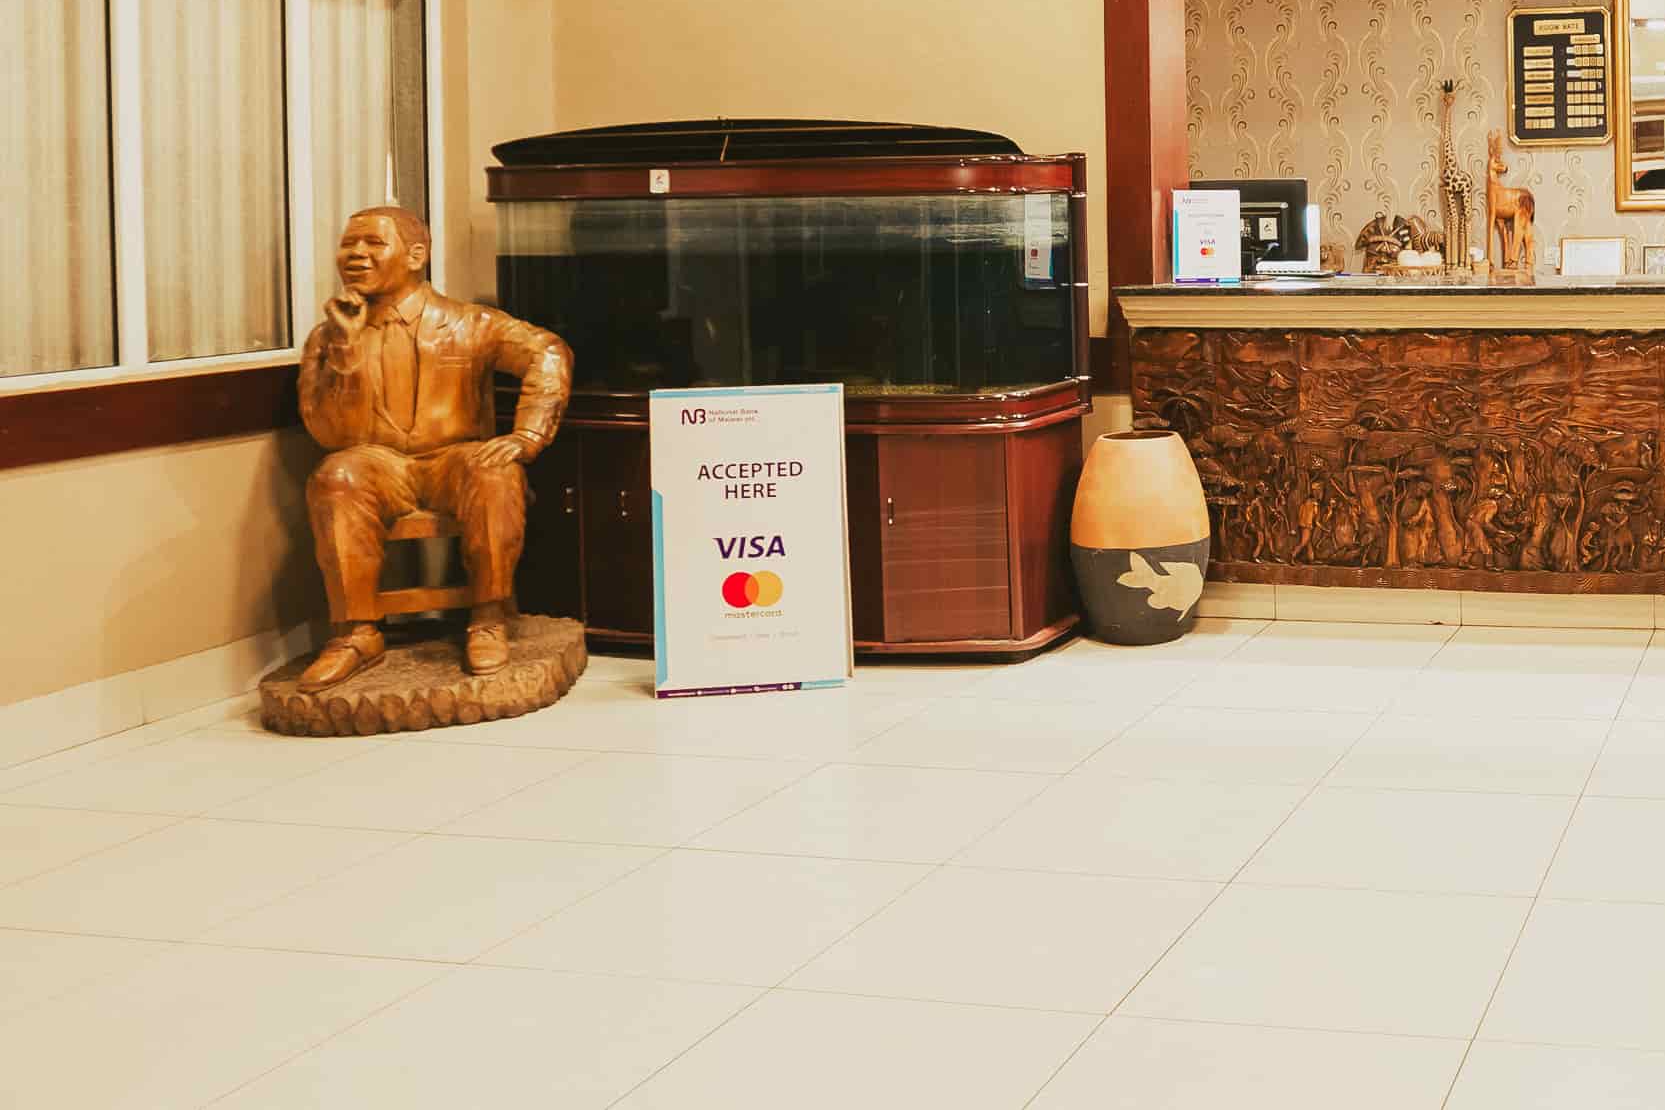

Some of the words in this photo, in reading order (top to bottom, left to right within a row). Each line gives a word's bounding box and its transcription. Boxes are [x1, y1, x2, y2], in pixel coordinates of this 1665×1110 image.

[697, 461, 803, 481] ACCEPTED
[724, 482, 777, 500] HERE
[712, 535, 786, 560] VISA
